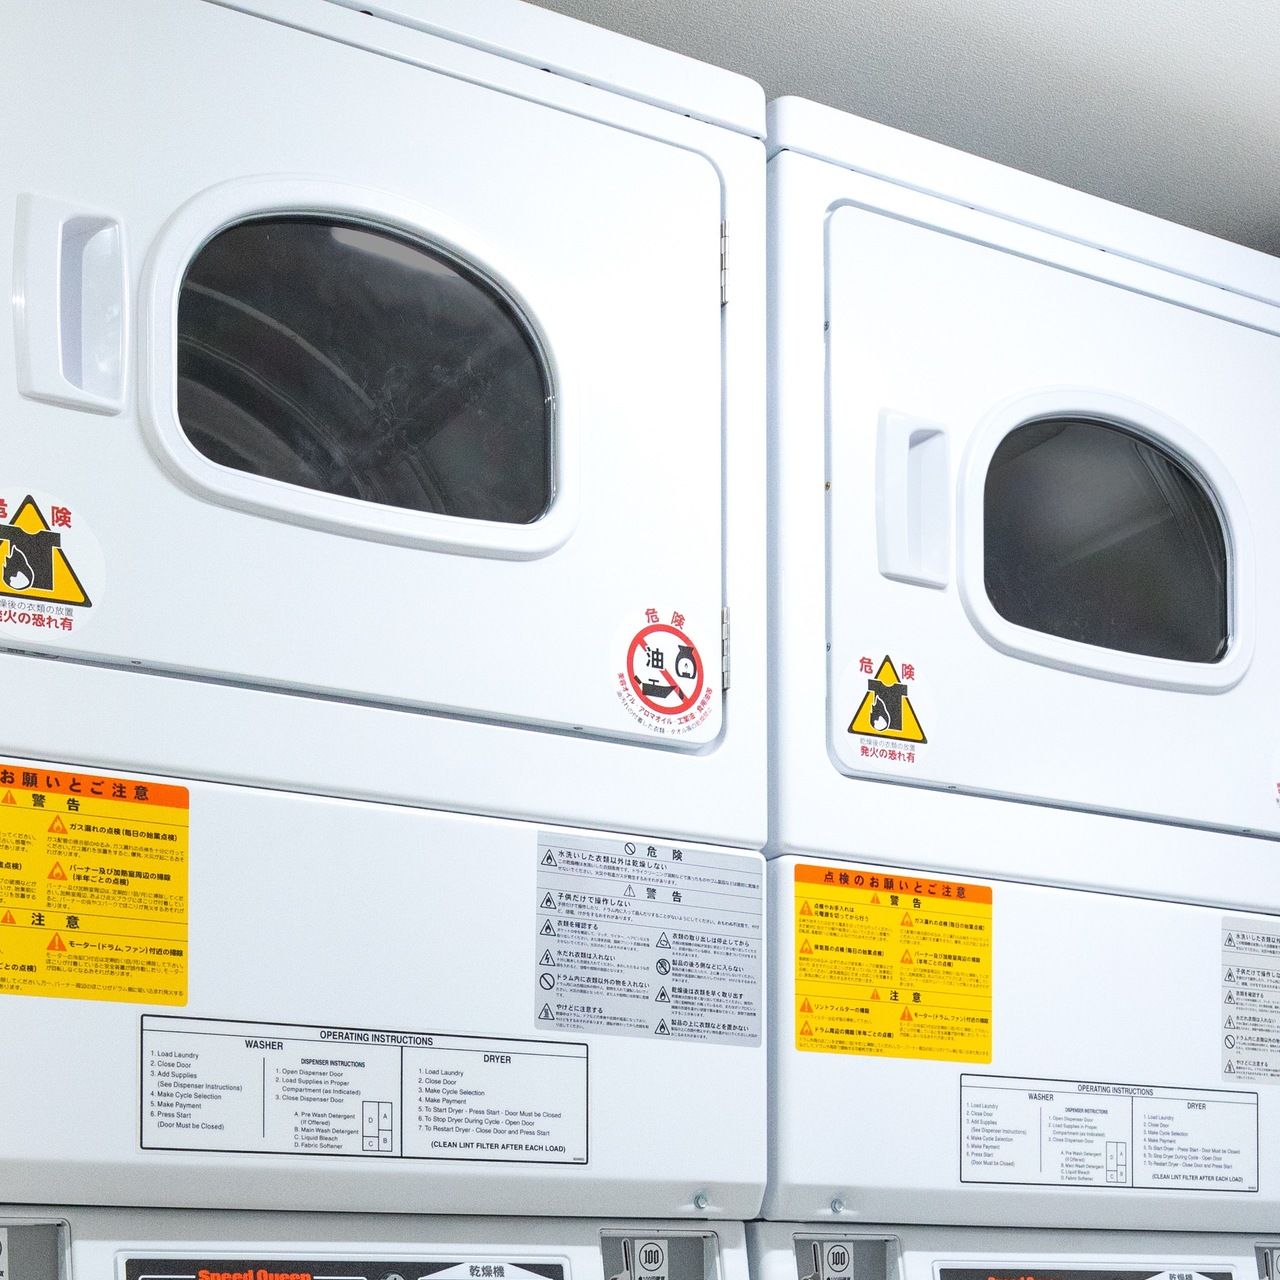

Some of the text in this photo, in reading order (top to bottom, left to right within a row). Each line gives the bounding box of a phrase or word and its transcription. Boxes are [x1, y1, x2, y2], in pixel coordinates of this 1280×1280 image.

[646, 646, 664, 669] 油
[860, 746, 915, 763] 発火の恐れ有
[824, 872, 966, 899] 点検のお願いとご注意
[558, 893, 631, 907] 子供だけで操作しない
[558, 920, 598, 930] 衣類を確認する
[556, 1004, 603, 1014] やけどに注意する
[320, 1030, 433, 1045] OPERATING INSTRUCTIONS
[245, 1040, 283, 1050] WASHER
[330, 1060, 365, 1068] INSTRUCTIONS
[483, 1055, 511, 1064] DRYER
[1078, 1084, 1153, 1096] OPERATING INSTRUCTIONS
[1028, 1093, 1054, 1101] WASHER
[431, 1141, 457, 1149] (CLEAN
[644, 1250, 659, 1264] 100
[832, 1251, 845, 1265] 100
[469, 1265, 505, 1278] 乾燥機
